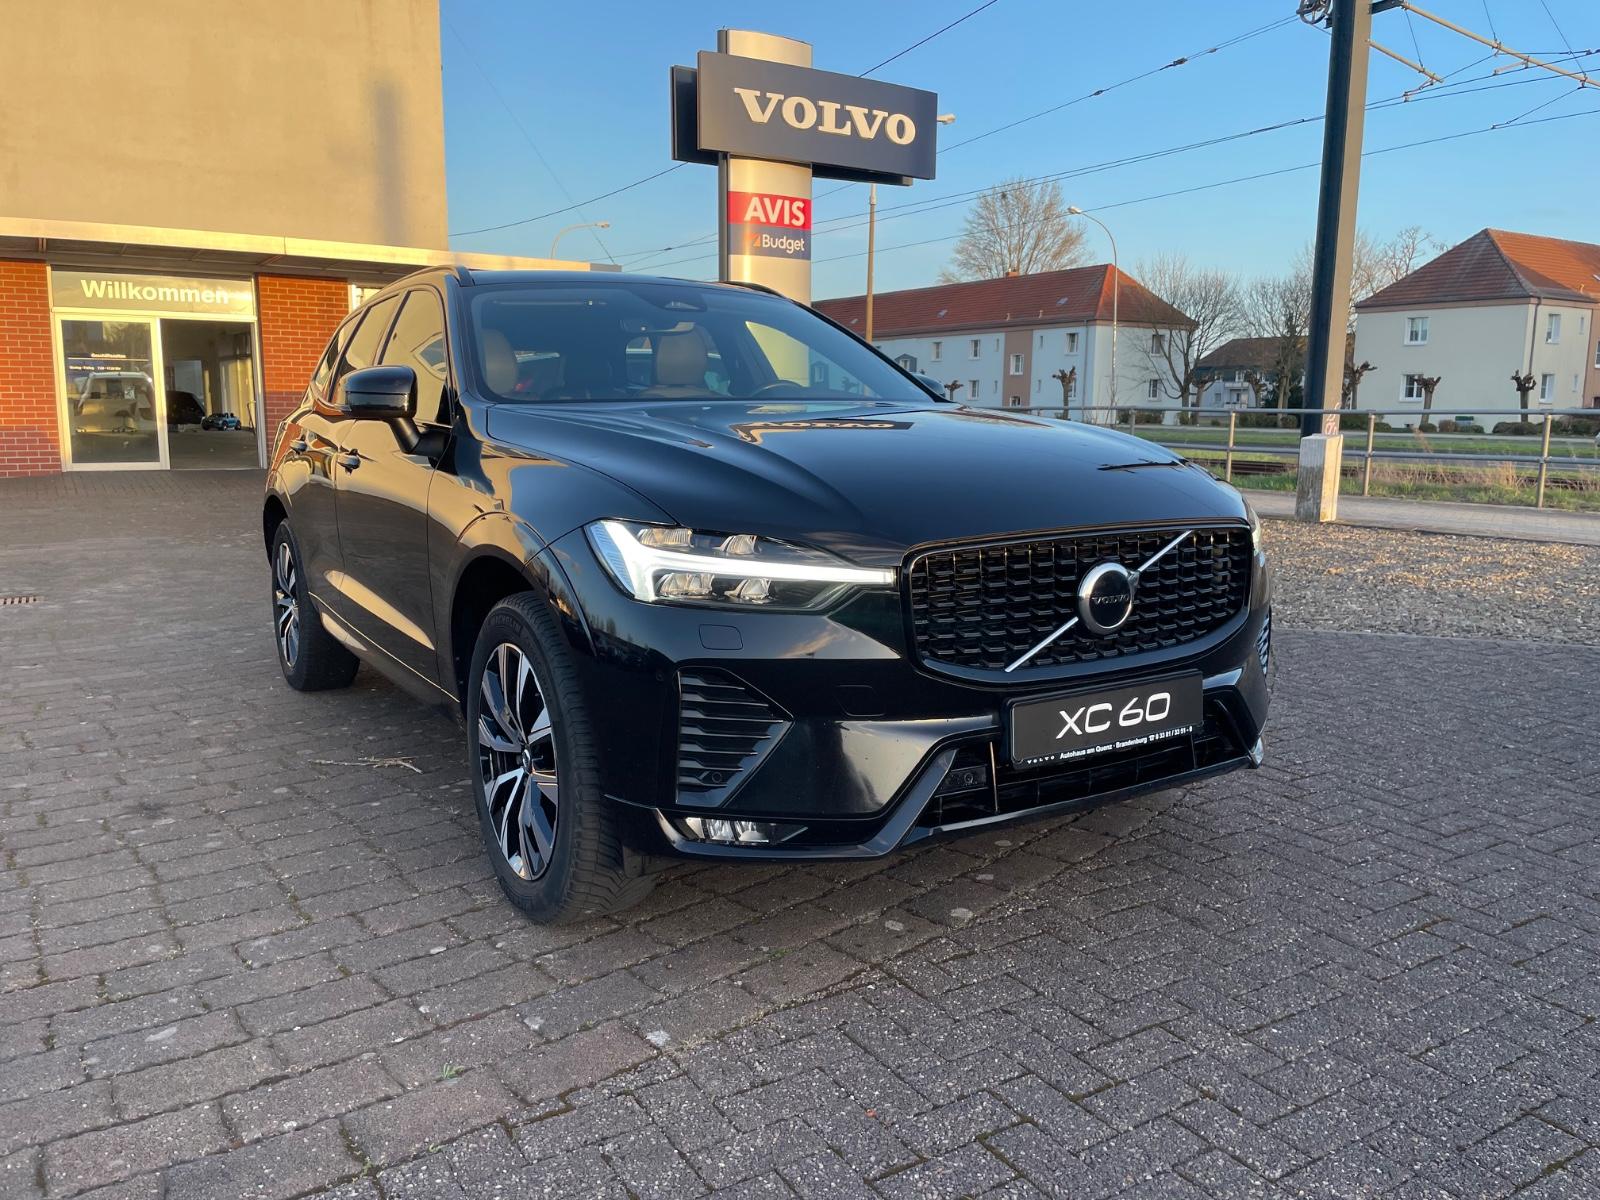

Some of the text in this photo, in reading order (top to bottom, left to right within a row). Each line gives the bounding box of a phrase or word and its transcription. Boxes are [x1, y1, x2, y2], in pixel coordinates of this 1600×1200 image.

[733, 87, 916, 145] VOLVO
[743, 197, 805, 227] AVIS
[762, 233, 805, 254] Budget
[80, 279, 229, 305] Willkommen
[1091, 593, 1130, 605] VOLVO
[1027, 755, 1055, 764] VOLVO
[1060, 750, 1086, 759] Autohaus
